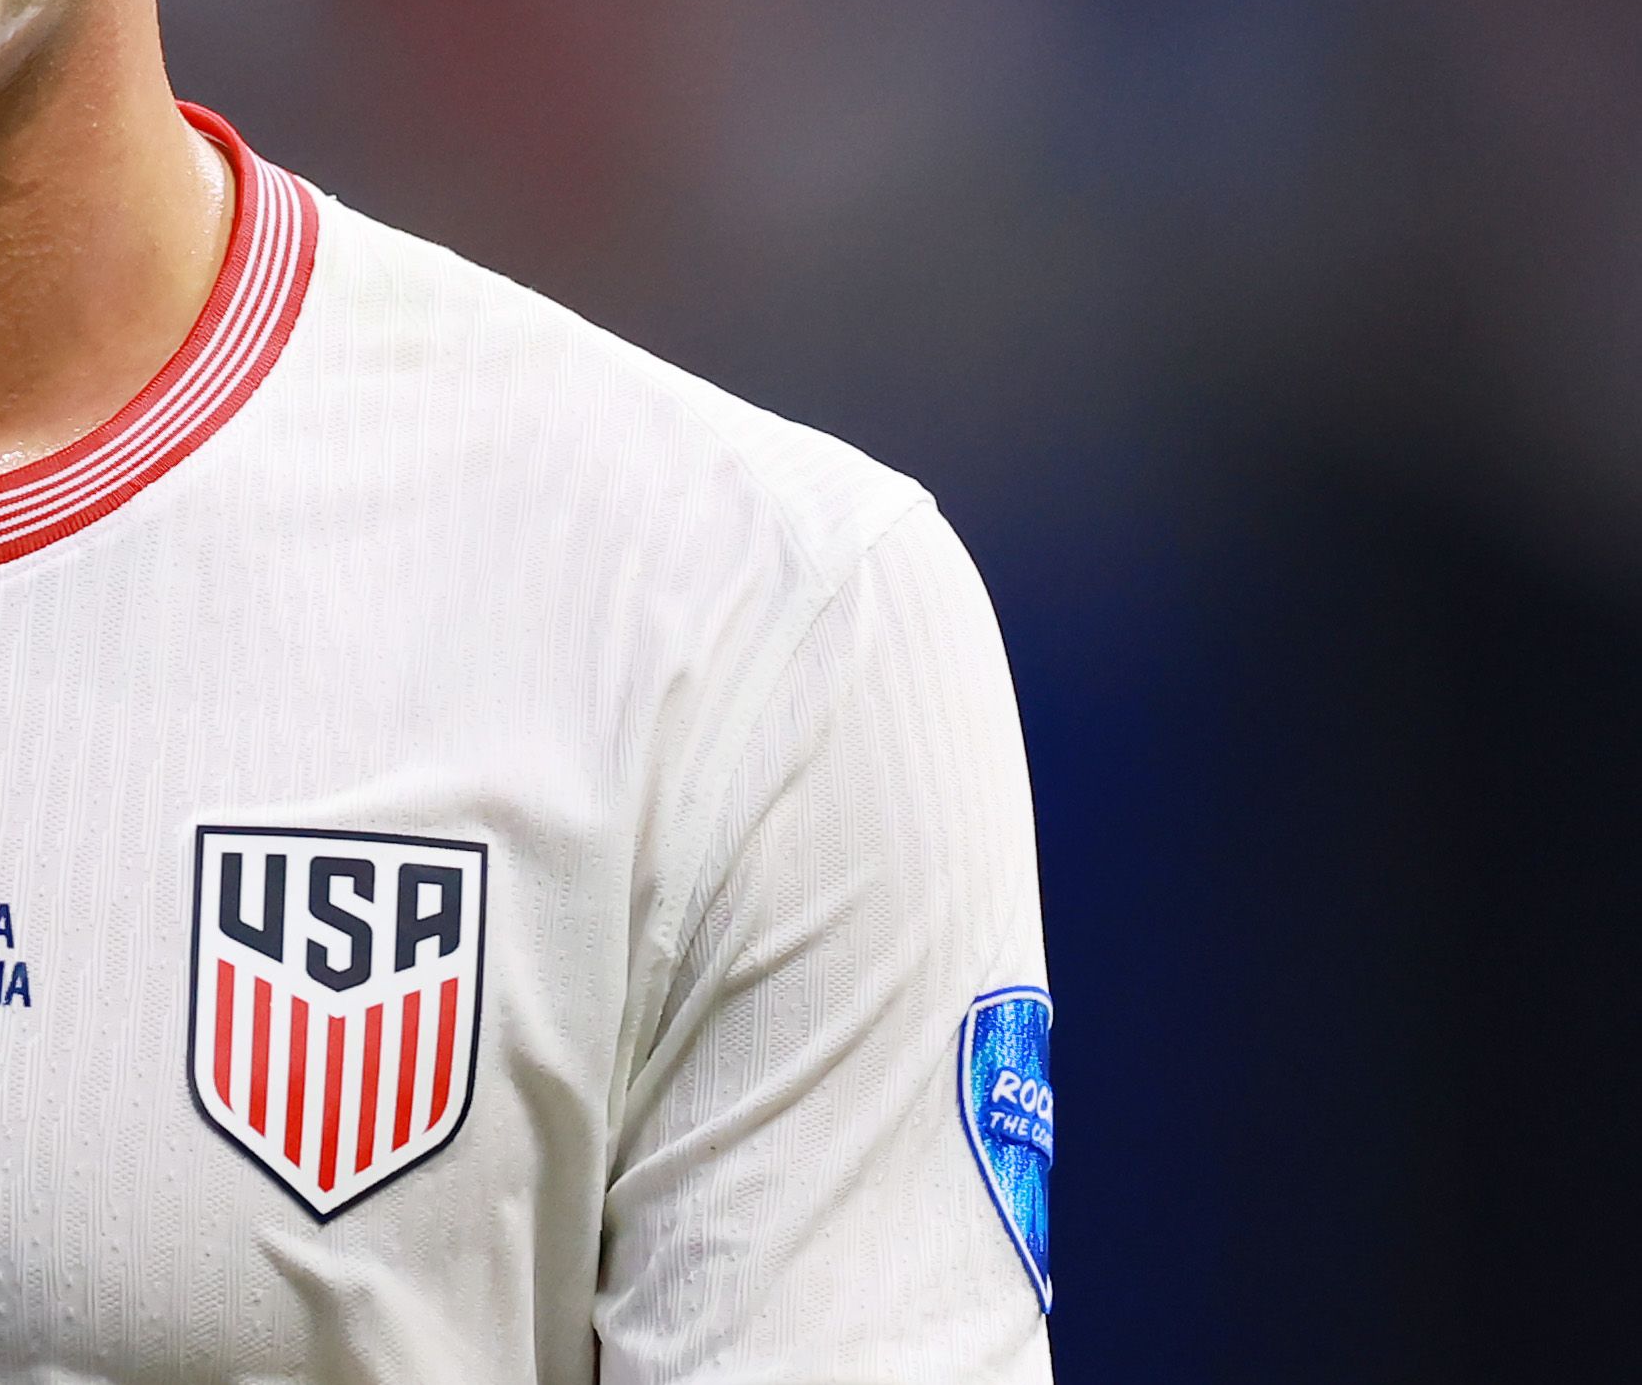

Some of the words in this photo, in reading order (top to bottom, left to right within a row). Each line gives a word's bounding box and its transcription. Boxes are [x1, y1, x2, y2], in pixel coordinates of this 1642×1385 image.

[218, 851, 463, 993] USA
[991, 1070, 1054, 1120] ROC
[990, 1111, 1031, 1137] THE
